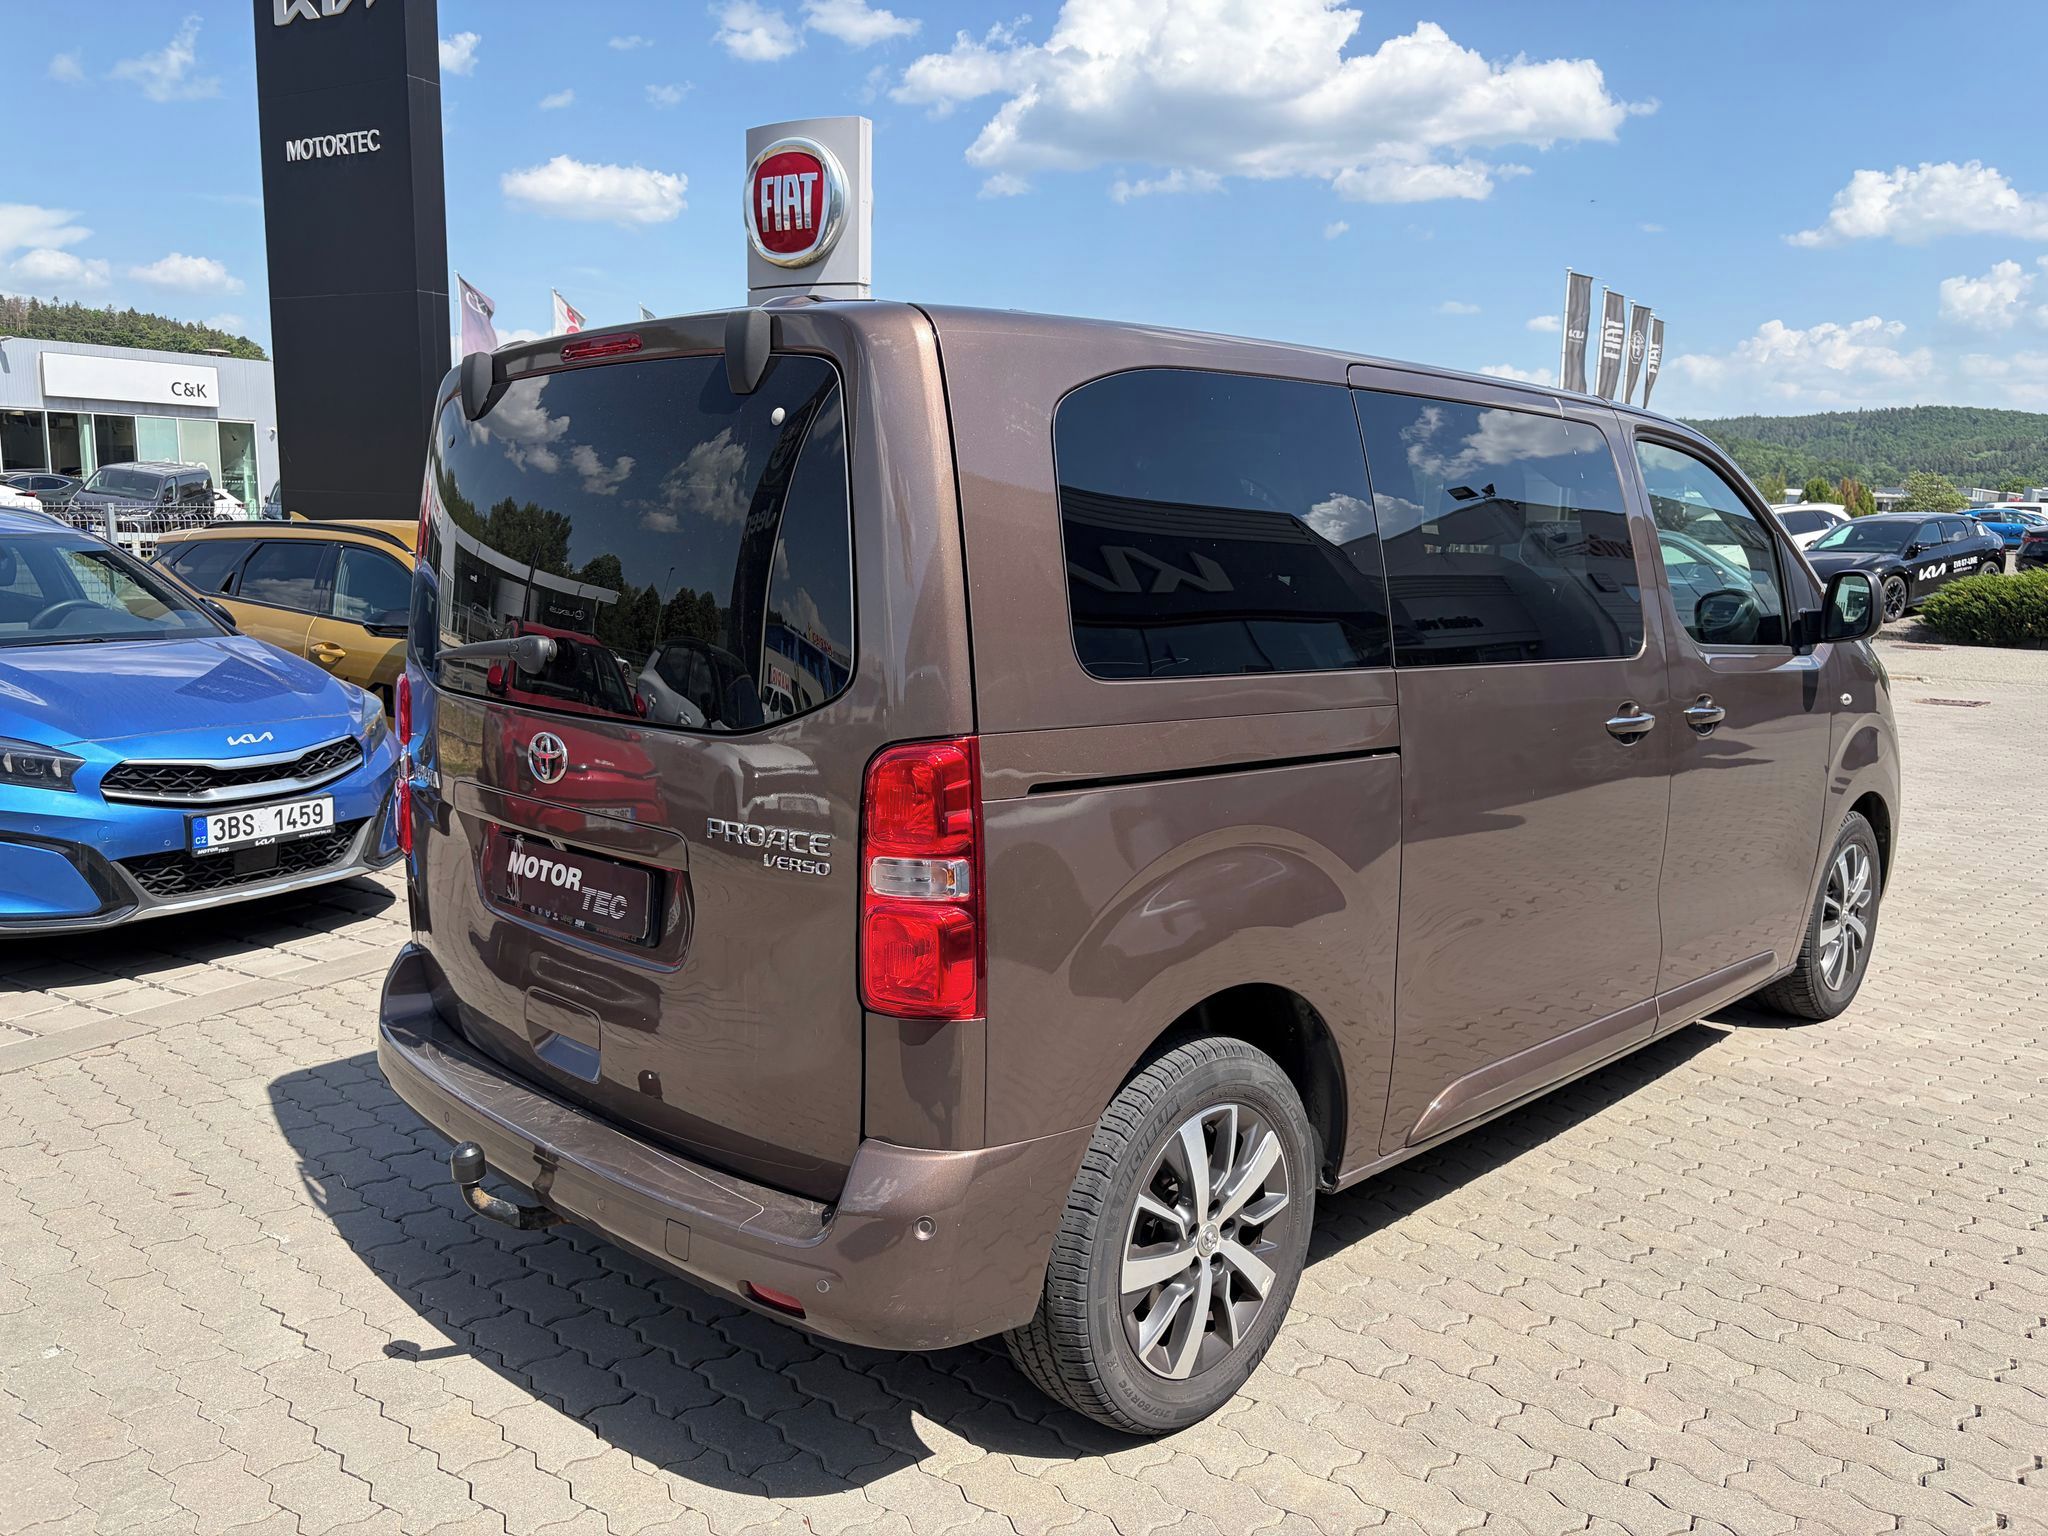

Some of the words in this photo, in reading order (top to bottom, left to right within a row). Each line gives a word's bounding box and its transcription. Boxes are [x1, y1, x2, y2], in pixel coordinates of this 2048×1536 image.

[286, 129, 381, 162] MOTORTEC
[760, 172, 818, 233] FIAT
[1603, 317, 1624, 360] FIAT
[171, 381, 208, 399] C&K
[1919, 562, 1947, 581] KIA
[227, 731, 274, 746] KIA
[213, 813, 255, 842] 3BS
[274, 802, 324, 832] 1459
[706, 817, 832, 858] PROACE
[195, 834, 207, 845] CZ
[507, 851, 583, 891] MOTOR
[763, 853, 831, 876] VERSO
[581, 886, 628, 920] TEC
[1114, 1094, 1182, 1205] MICHELIN
